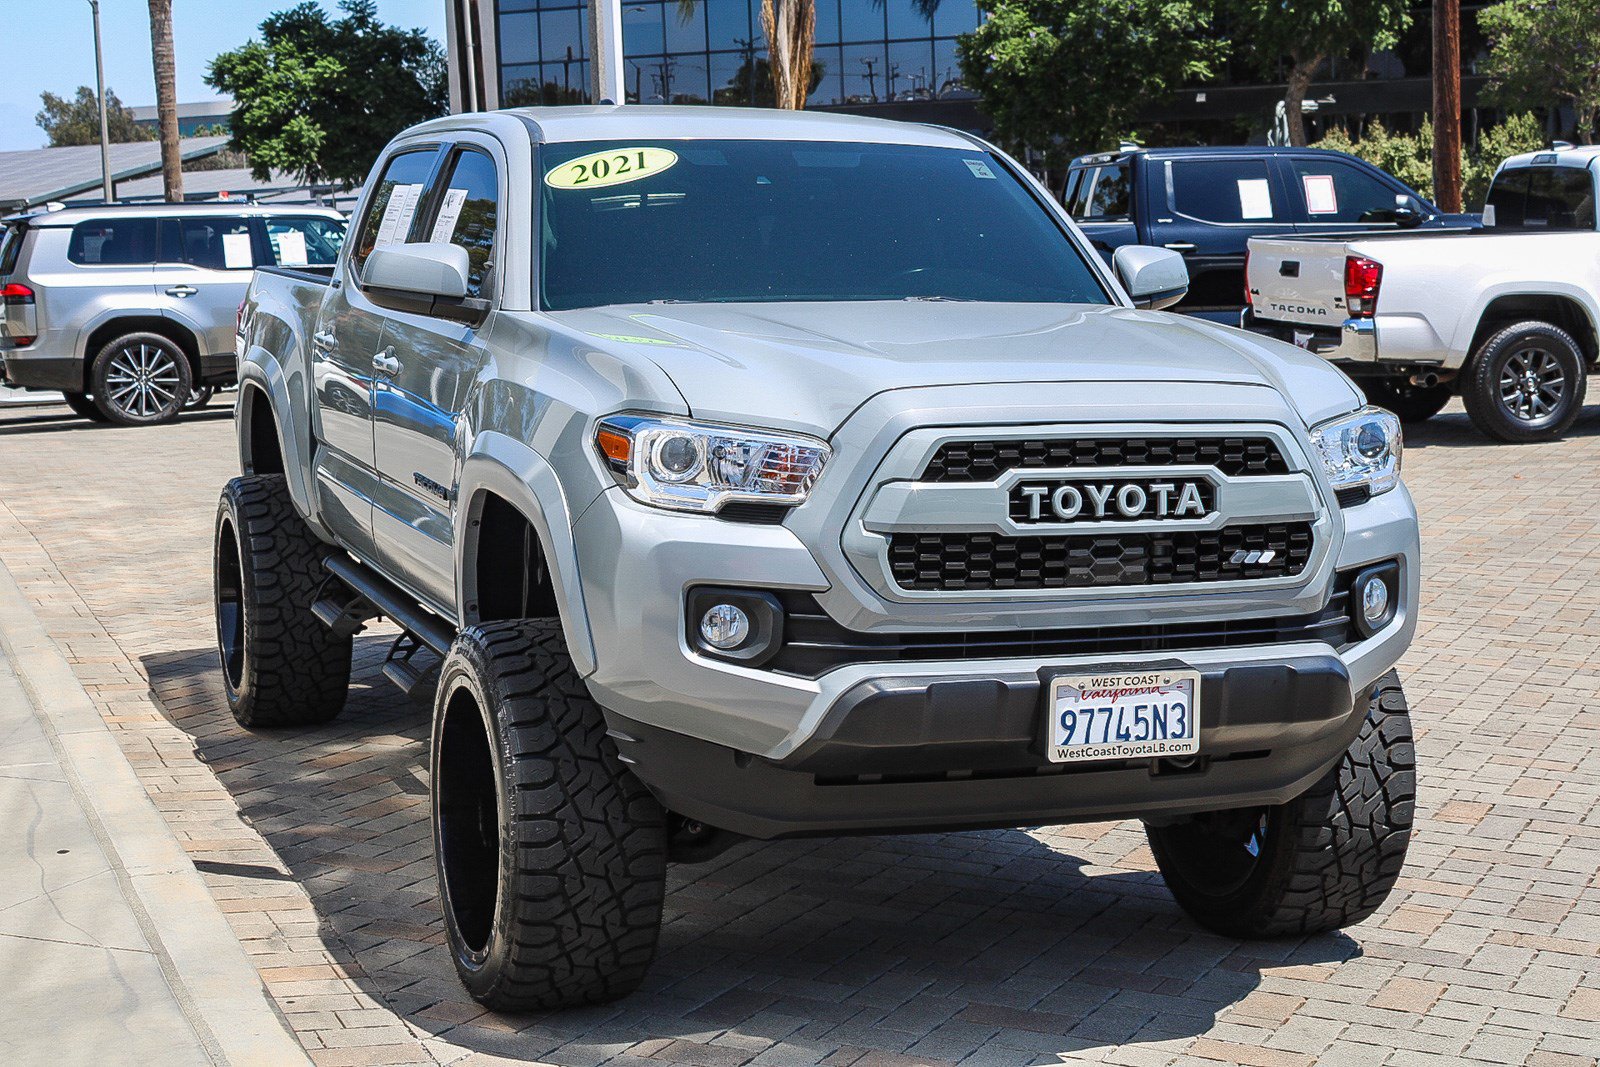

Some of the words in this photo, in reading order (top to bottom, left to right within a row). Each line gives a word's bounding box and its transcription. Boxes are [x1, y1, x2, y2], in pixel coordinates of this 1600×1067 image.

[571, 152, 647, 184] 2021
[1270, 303, 1327, 316] TACOMA
[1021, 482, 1206, 520] TOYOTA
[1091, 676, 1122, 688] WEST
[1124, 674, 1160, 686] COAST
[1060, 702, 1186, 746] 97745N3
[1057, 742, 1192, 759] WestCoastToyotaLB.com
